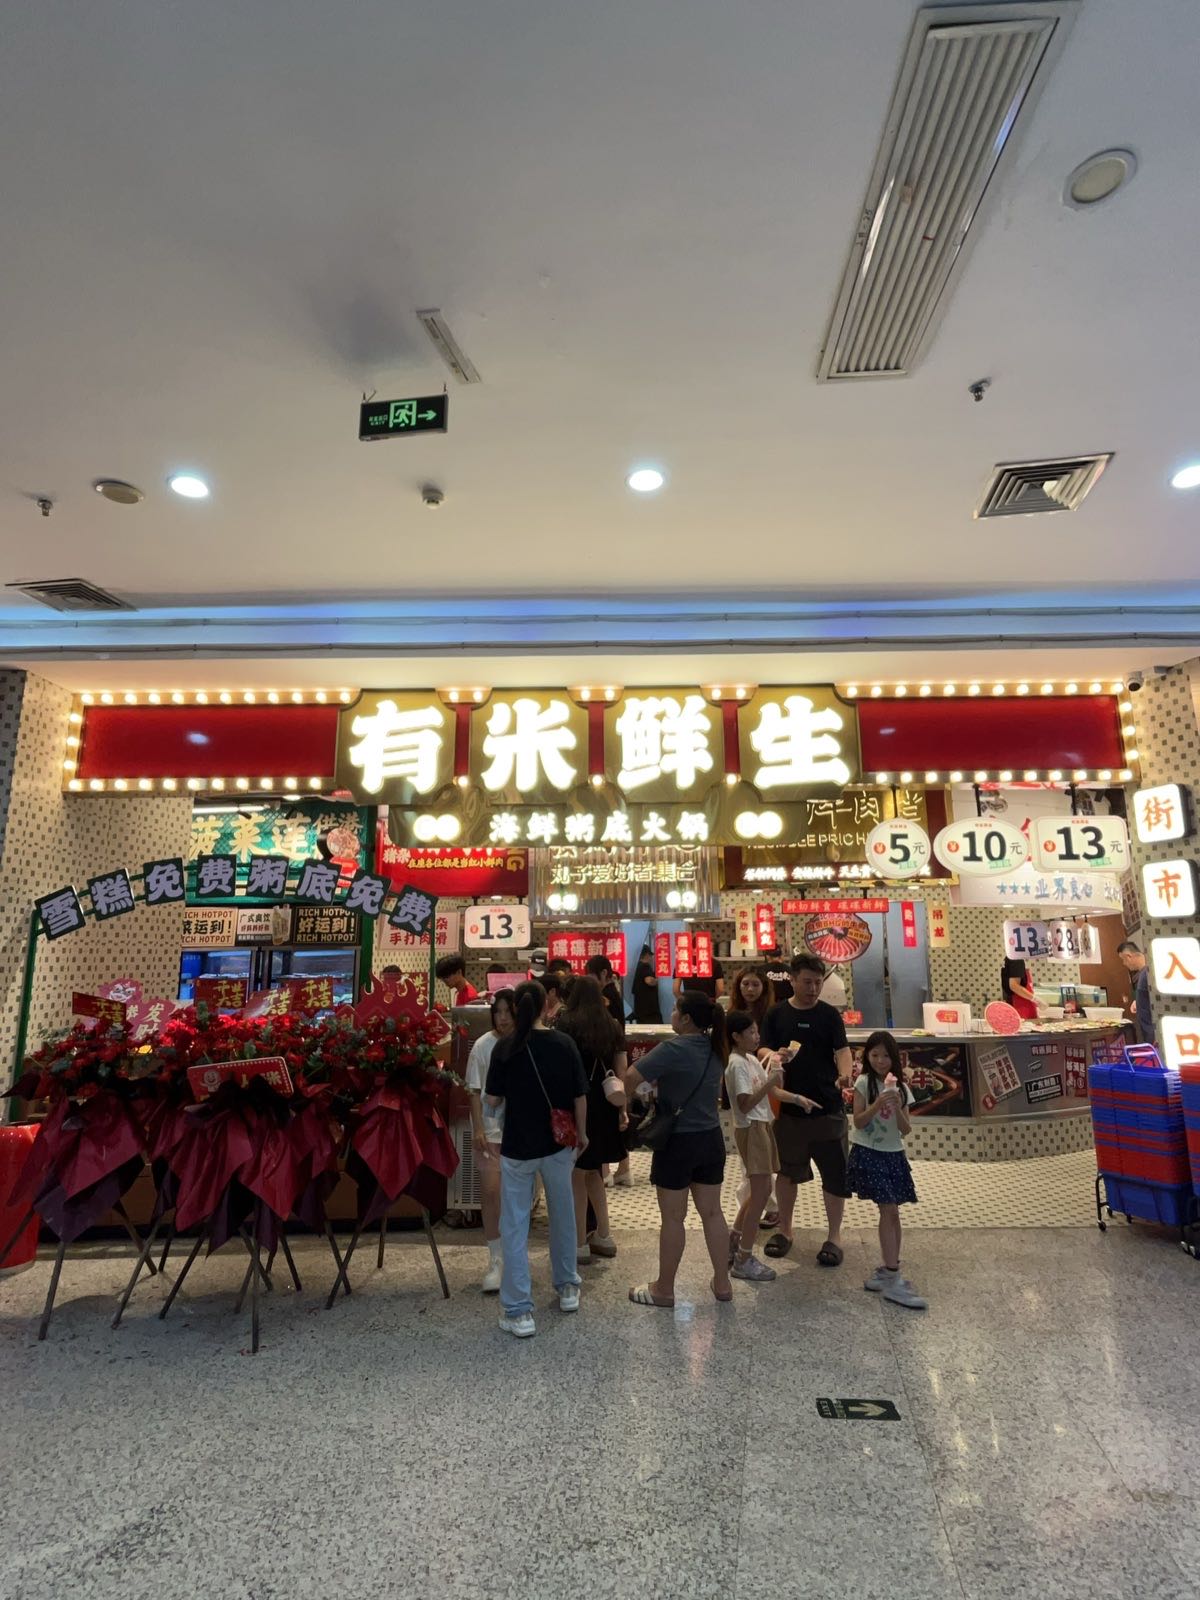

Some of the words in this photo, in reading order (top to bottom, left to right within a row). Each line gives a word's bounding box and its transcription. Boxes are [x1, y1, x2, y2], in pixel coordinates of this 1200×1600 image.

[349, 695, 851, 794] 有米鲜生
[188, 813, 324, 863] 菠菜莲
[489, 811, 710, 844] 海鲜粥底火锅
[889, 833, 911, 864] 5
[962, 831, 1007, 861] 10
[1057, 826, 1106, 860] 13
[41, 857, 432, 936] 雪糕免费粥底免费
[201, 910, 233, 919] HOTPOT
[298, 908, 319, 917] RICH
[299, 918, 355, 933] 好运到!
[1142, 795, 1200, 1057] 街市入口
[199, 935, 231, 943] HOTPOT
[297, 934, 319, 943] RICH
[322, 933, 354, 942] HOTPOT
[479, 914, 513, 941] 13
[1013, 926, 1039, 952] 13
[1056, 927, 1074, 952] 28
